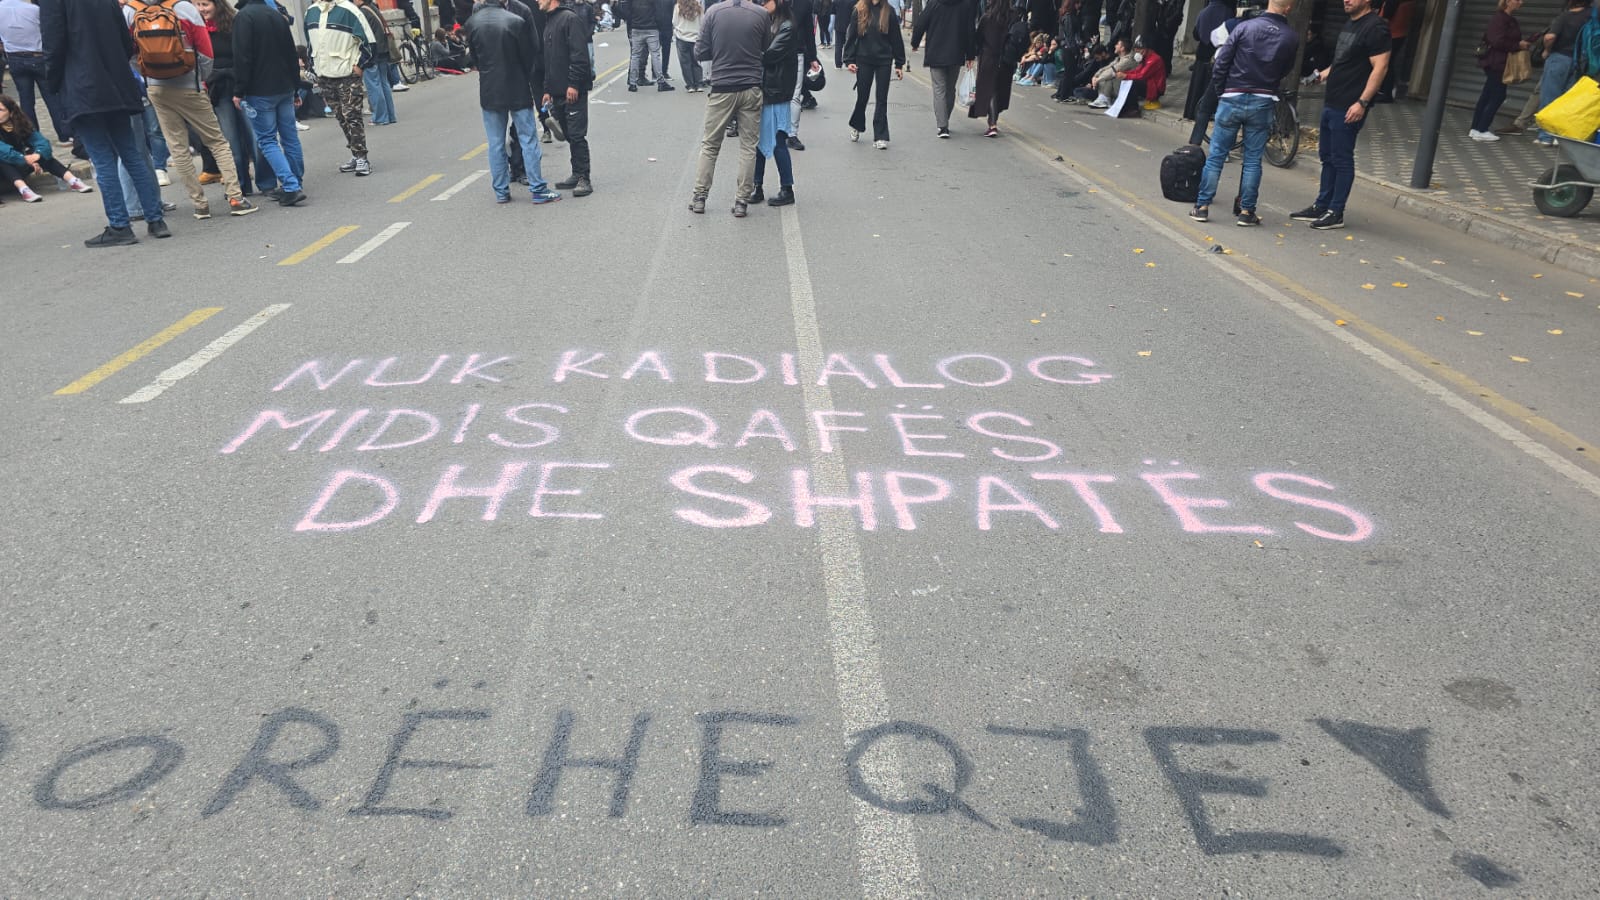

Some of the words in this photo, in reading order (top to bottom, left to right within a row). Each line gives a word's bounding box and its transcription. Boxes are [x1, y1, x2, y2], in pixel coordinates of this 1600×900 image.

[271, 353, 511, 391] NUK
[704, 352, 1113, 389] DIALOG
[221, 402, 569, 453] MIDIS
[624, 403, 1063, 462] QAFËS
[295, 463, 611, 531] DHE
[668, 459, 1376, 541] SHPATËS
[0, 679, 1523, 888] ORËHEQJE!
